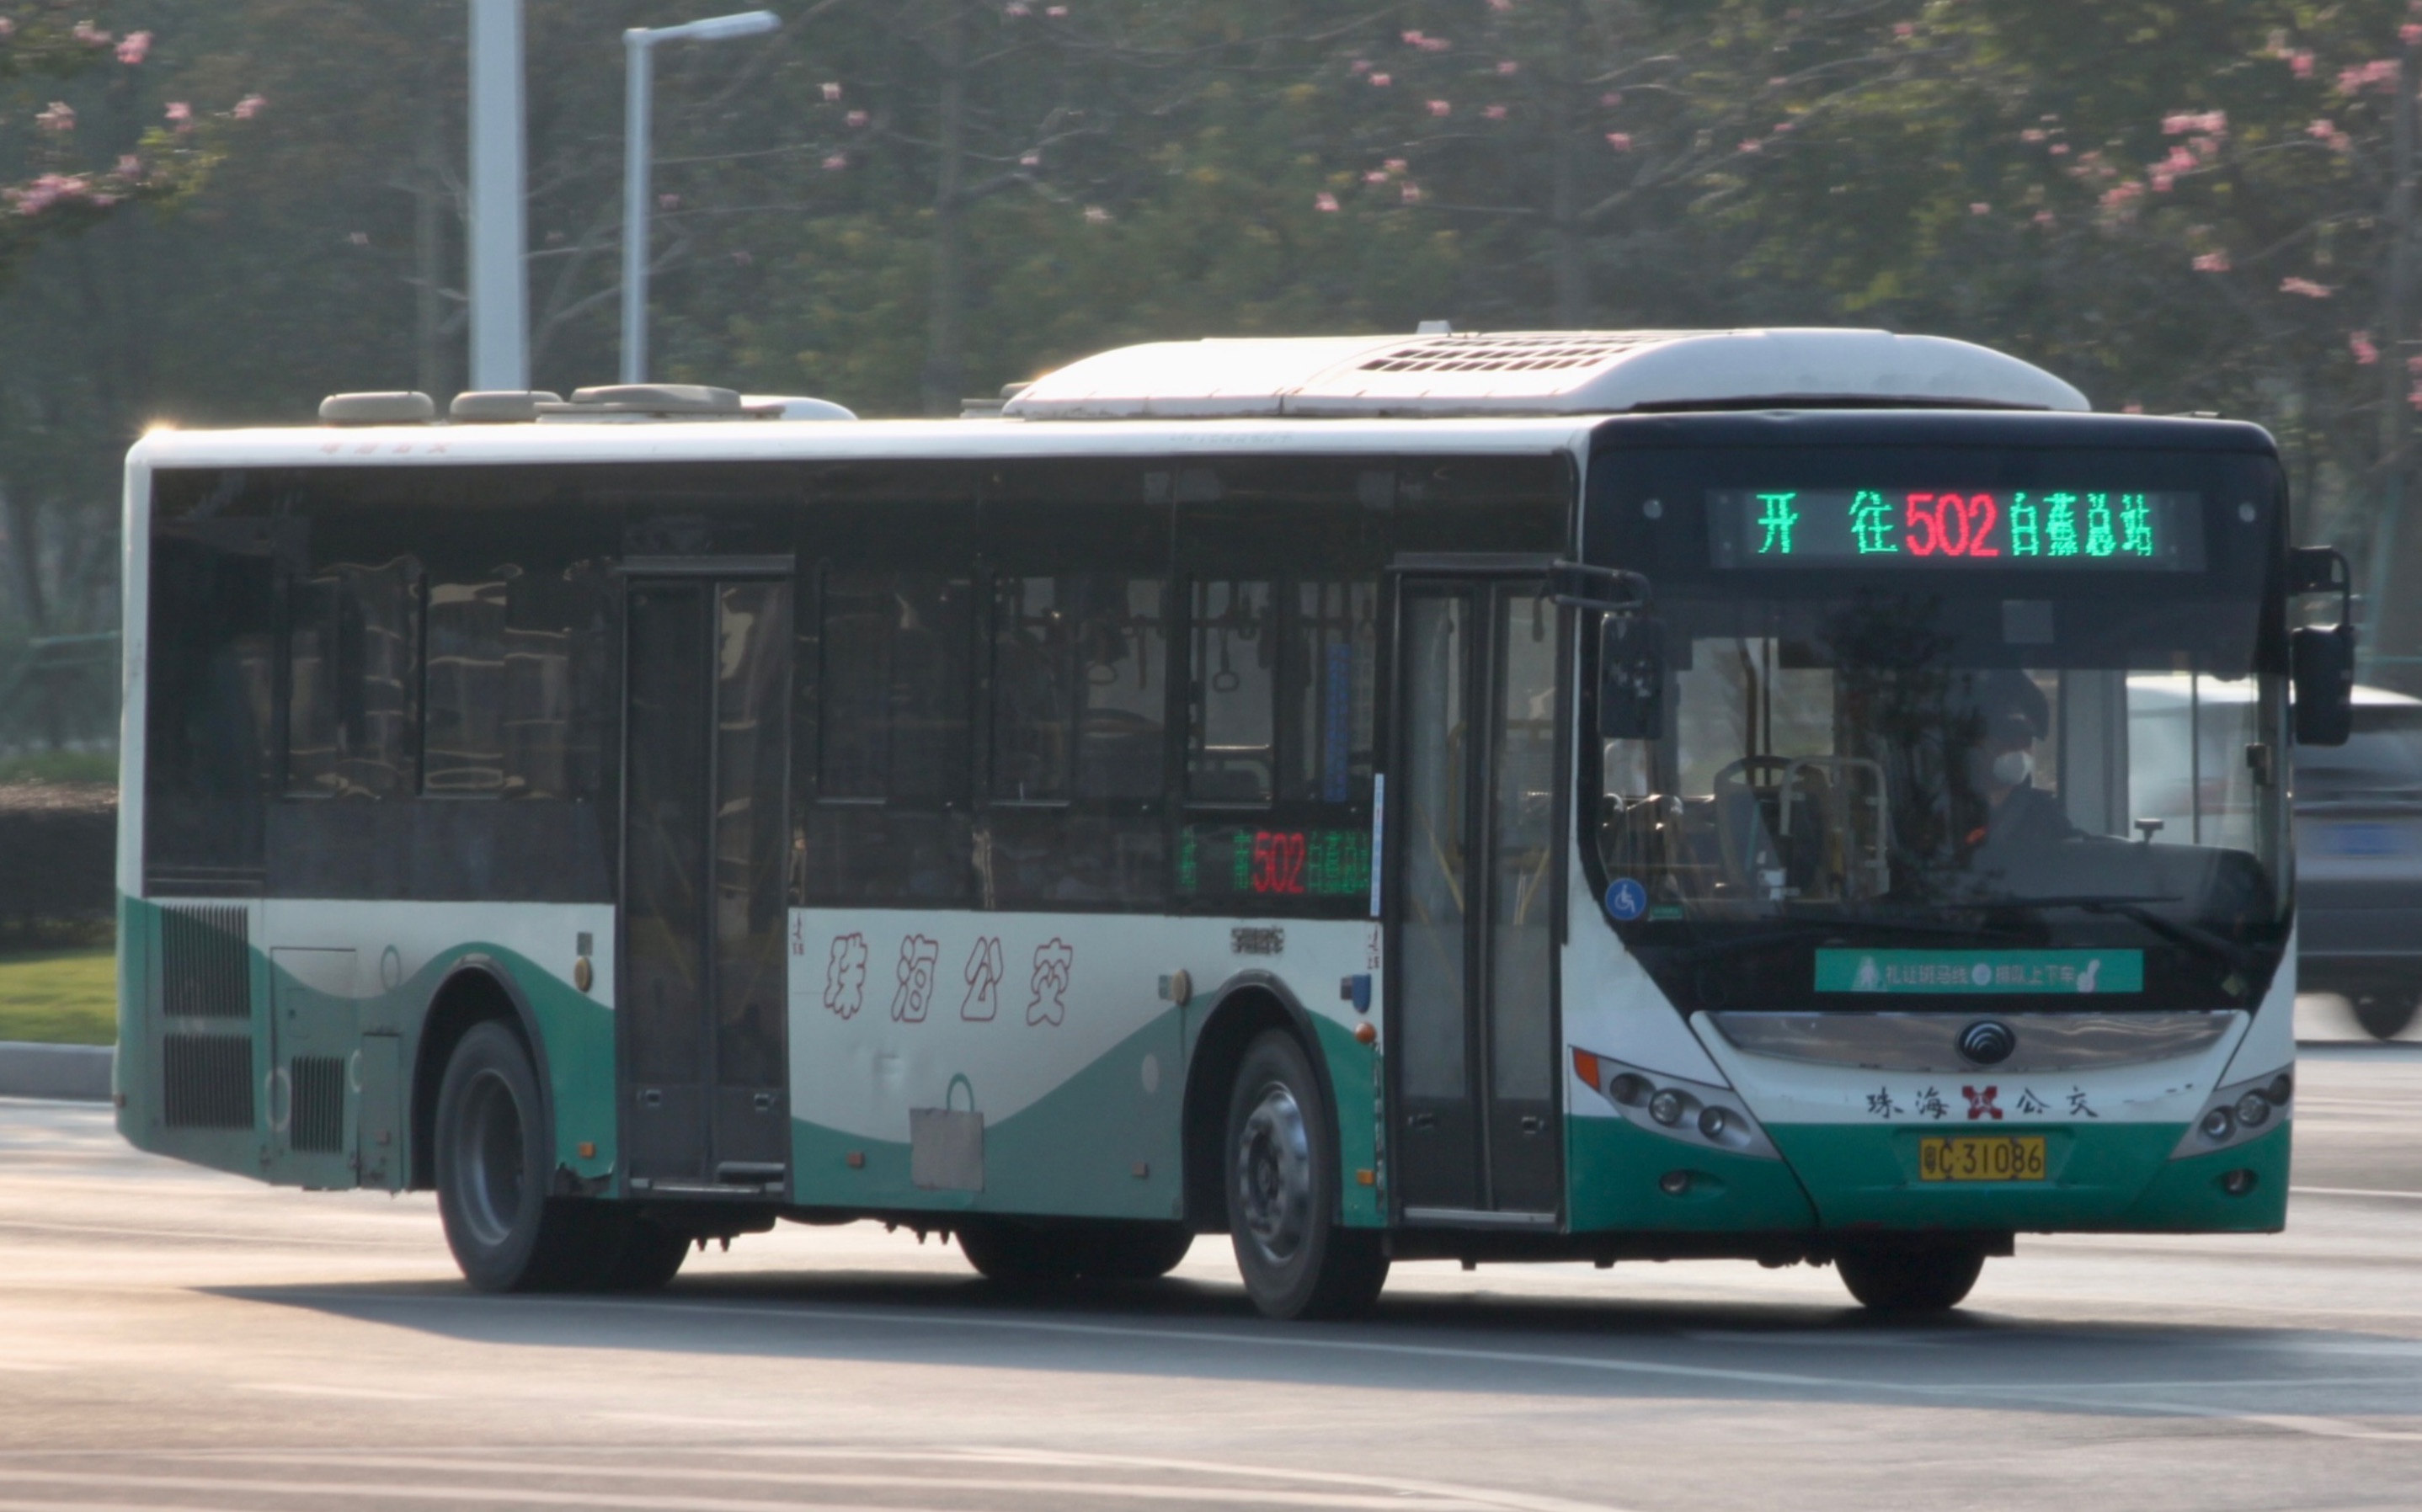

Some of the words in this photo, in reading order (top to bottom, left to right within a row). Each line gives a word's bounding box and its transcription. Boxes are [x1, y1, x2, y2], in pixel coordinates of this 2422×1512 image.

[1757, 492, 1797, 553] 开
[1849, 492, 1897, 553] 往
[1906, 493, 1999, 556] 502
[2010, 492, 2153, 556] 白蕉总站
[1253, 831, 1304, 892] 502
[1866, 1086, 1950, 1119] 珠海
[2016, 1086, 2099, 1118] 公交
